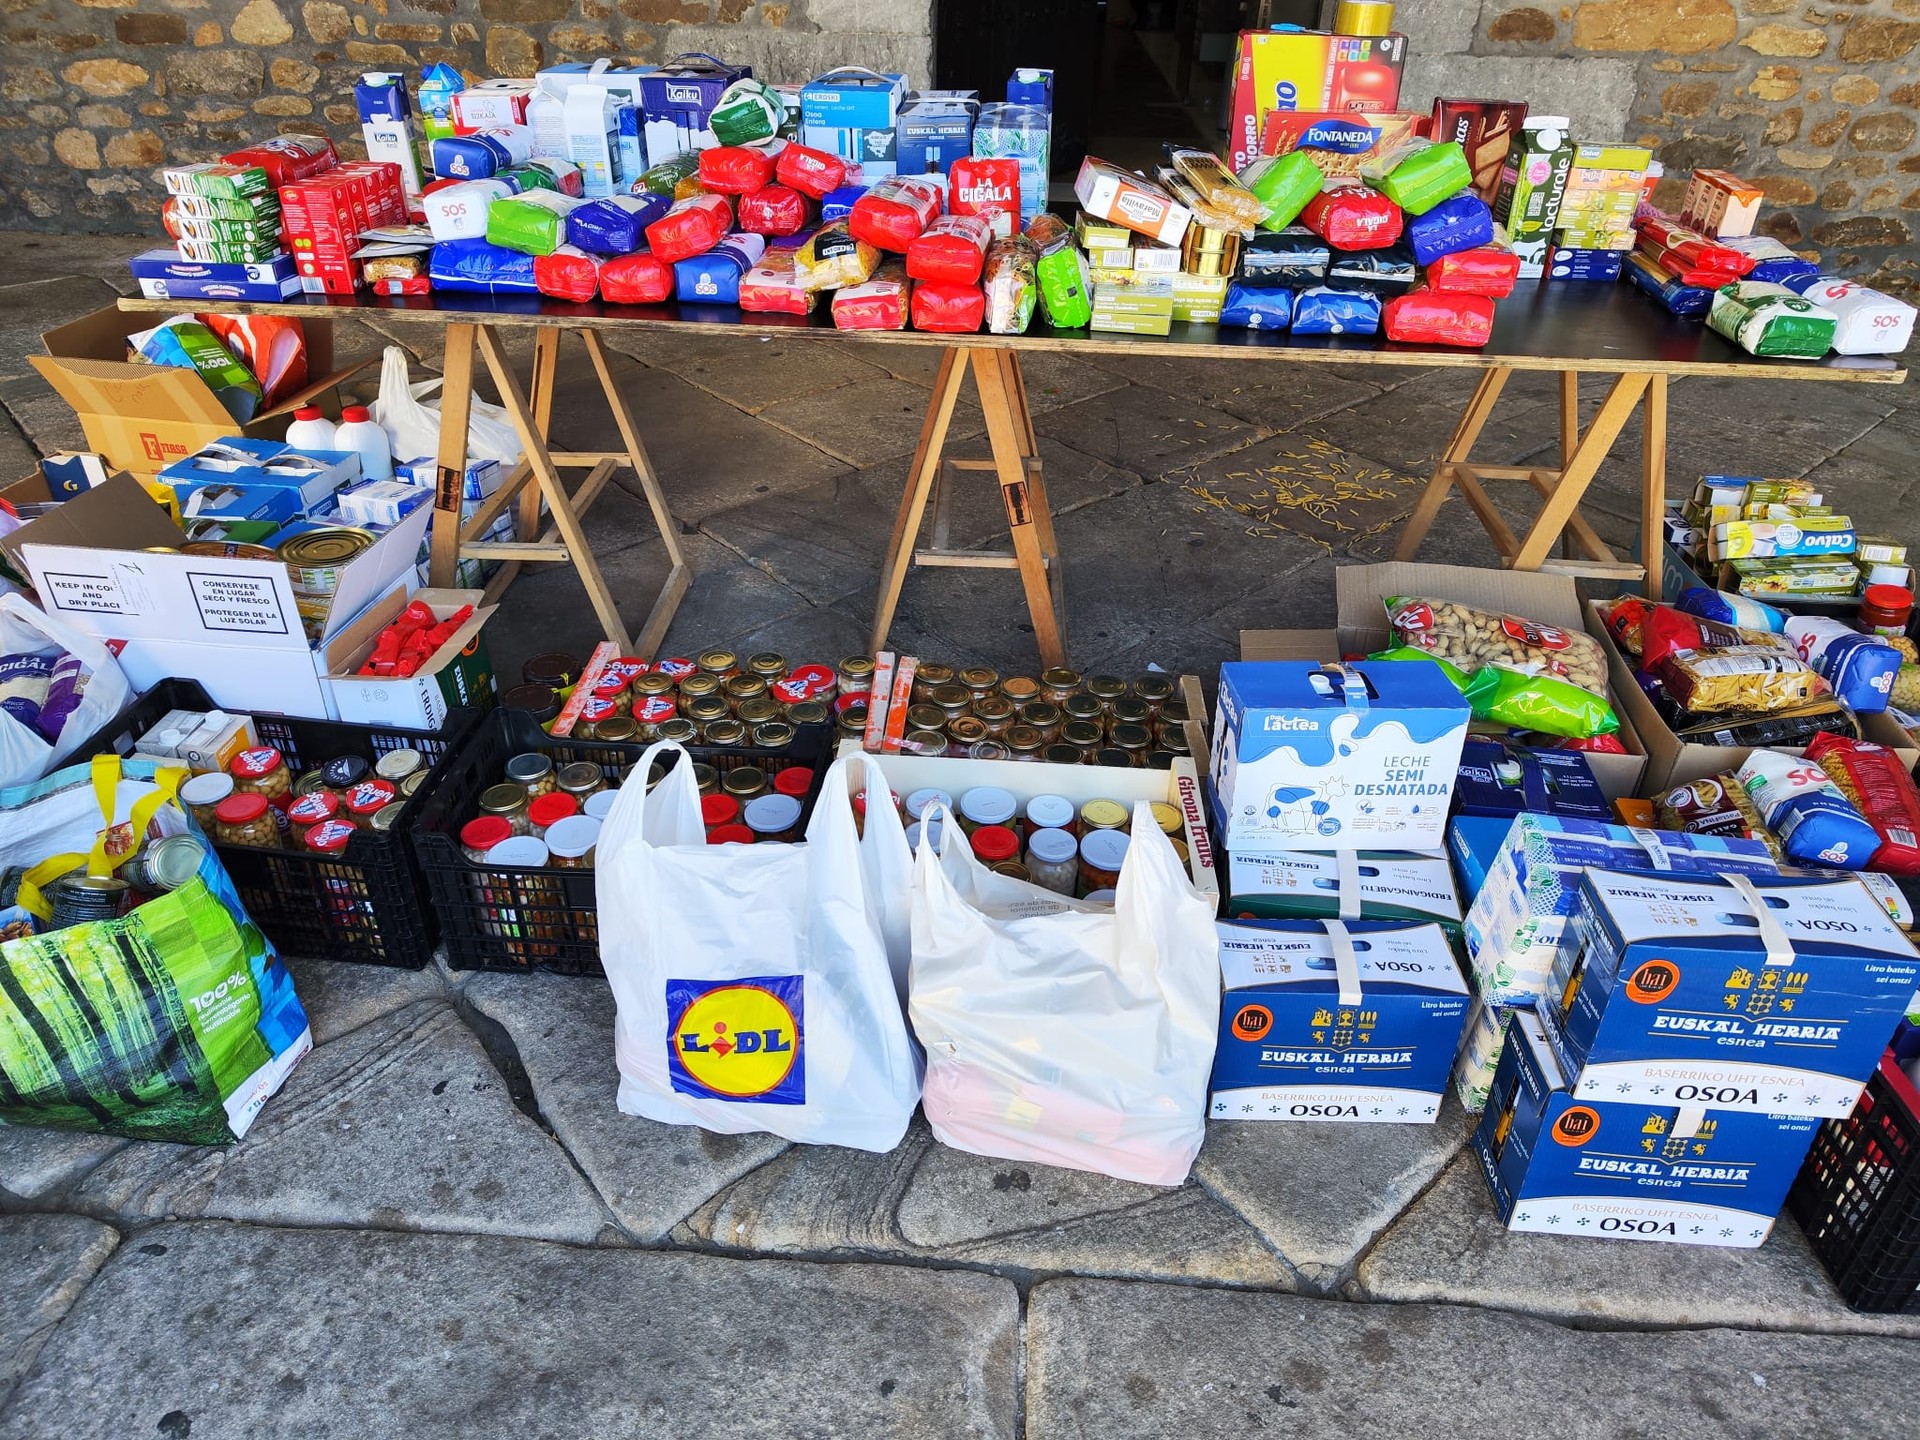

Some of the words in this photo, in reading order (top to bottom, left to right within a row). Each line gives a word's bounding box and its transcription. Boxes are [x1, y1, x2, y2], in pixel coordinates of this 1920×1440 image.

[670, 87, 698, 100] Kaiku
[907, 127, 936, 135] EUSKAL
[1308, 127, 1373, 143] FONTANEDA
[1456, 117, 1470, 149] nas
[376, 134, 396, 142] Kaiku
[1581, 150, 1600, 158] Calvo
[450, 164, 468, 174] SOS
[977, 178, 993, 188] LA
[959, 188, 1012, 202] CIGALA
[1540, 158, 1570, 232] lacturale
[441, 203, 467, 217] SOS
[1121, 194, 1162, 218] Maravilla
[1356, 215, 1388, 226] CIGALA
[1366, 223, 1379, 232] LA
[697, 284, 717, 293] SOS
[1872, 315, 1901, 327] SOS
[197, 356, 233, 371] 100%
[1805, 534, 1853, 547] Calvo
[55, 581, 80, 590] KEEP
[202, 581, 260, 590] CONSERVESE
[226, 589, 256, 597] LUGAR
[68, 599, 89, 607] DRY
[202, 594, 227, 602] SECO
[236, 596, 270, 605] FRESCO
[205, 608, 251, 618] PROTEGER
[253, 610, 264, 618] DE
[266, 611, 277, 619] LA
[219, 616, 236, 624] LUZ
[238, 617, 267, 625] SOLAR
[0, 661, 49, 672] CIGAL
[455, 665, 470, 706] EUSKA
[1879, 672, 1893, 693] SOS
[777, 680, 806, 699] uengo
[640, 696, 657, 719] uengo
[240, 751, 265, 773] uengo
[1384, 756, 1431, 767] LECHE
[1385, 770, 1424, 781] SEMI
[1458, 766, 1487, 777] Kaiku
[1786, 769, 1827, 787] SO
[1354, 784, 1448, 795] DESNATADA
[1177, 775, 1204, 825] Girona
[315, 820, 336, 846] uengo
[1190, 825, 1214, 869] fruits
[1236, 856, 1275, 866] HERRIA
[1820, 851, 1847, 863] SOS
[1279, 861, 1320, 870] EUSKAL
[1360, 884, 1453, 901] ERDIGAINGABETU
[1607, 888, 1657, 899] HERRIA
[1666, 893, 1715, 902] EUSKAL
[1797, 919, 1858, 933] OSOA
[1223, 941, 1264, 950] HERRIA
[1267, 942, 1312, 950] EUSKAL
[1375, 961, 1422, 973] OSOA
[1865, 964, 1885, 973] Litro
[1886, 965, 1917, 975] bateko
[1889, 976, 1912, 985] ontzi
[189, 971, 248, 1013] 100%
[1546, 1013, 1565, 1054] OSOA
[1653, 1015, 1745, 1034] EUSKAL
[1753, 1023, 1841, 1040] HERRIA
[1717, 1035, 1766, 1048] esnea
[1261, 1051, 1335, 1064] EUSKAL
[1343, 1052, 1412, 1064] HERRIA
[1645, 1068, 1725, 1082] BASERRIKO
[1727, 1073, 1758, 1083] UHT
[1761, 1075, 1806, 1087] ESNEA
[1261, 1092, 1327, 1102] BASERRIKO
[1329, 1094, 1354, 1102] UHT
[1357, 1095, 1393, 1103] ESNEA
[1674, 1084, 1758, 1104] OSOA
[1290, 1104, 1359, 1117] OSOA
[1768, 1113, 1785, 1121] Litro
[1787, 1114, 1815, 1122] bateko
[1482, 1148, 1498, 1189] OSOA
[1579, 1158, 1662, 1175] EUSKAL
[1671, 1166, 1750, 1181] HERRIA
[1637, 1177, 1682, 1188] esnea
[1572, 1203, 1645, 1216] BASERRIKO
[1647, 1208, 1676, 1217] UHT
[1678, 1211, 1719, 1222] ESNEA
[1600, 1217, 1676, 1236] OSOA
